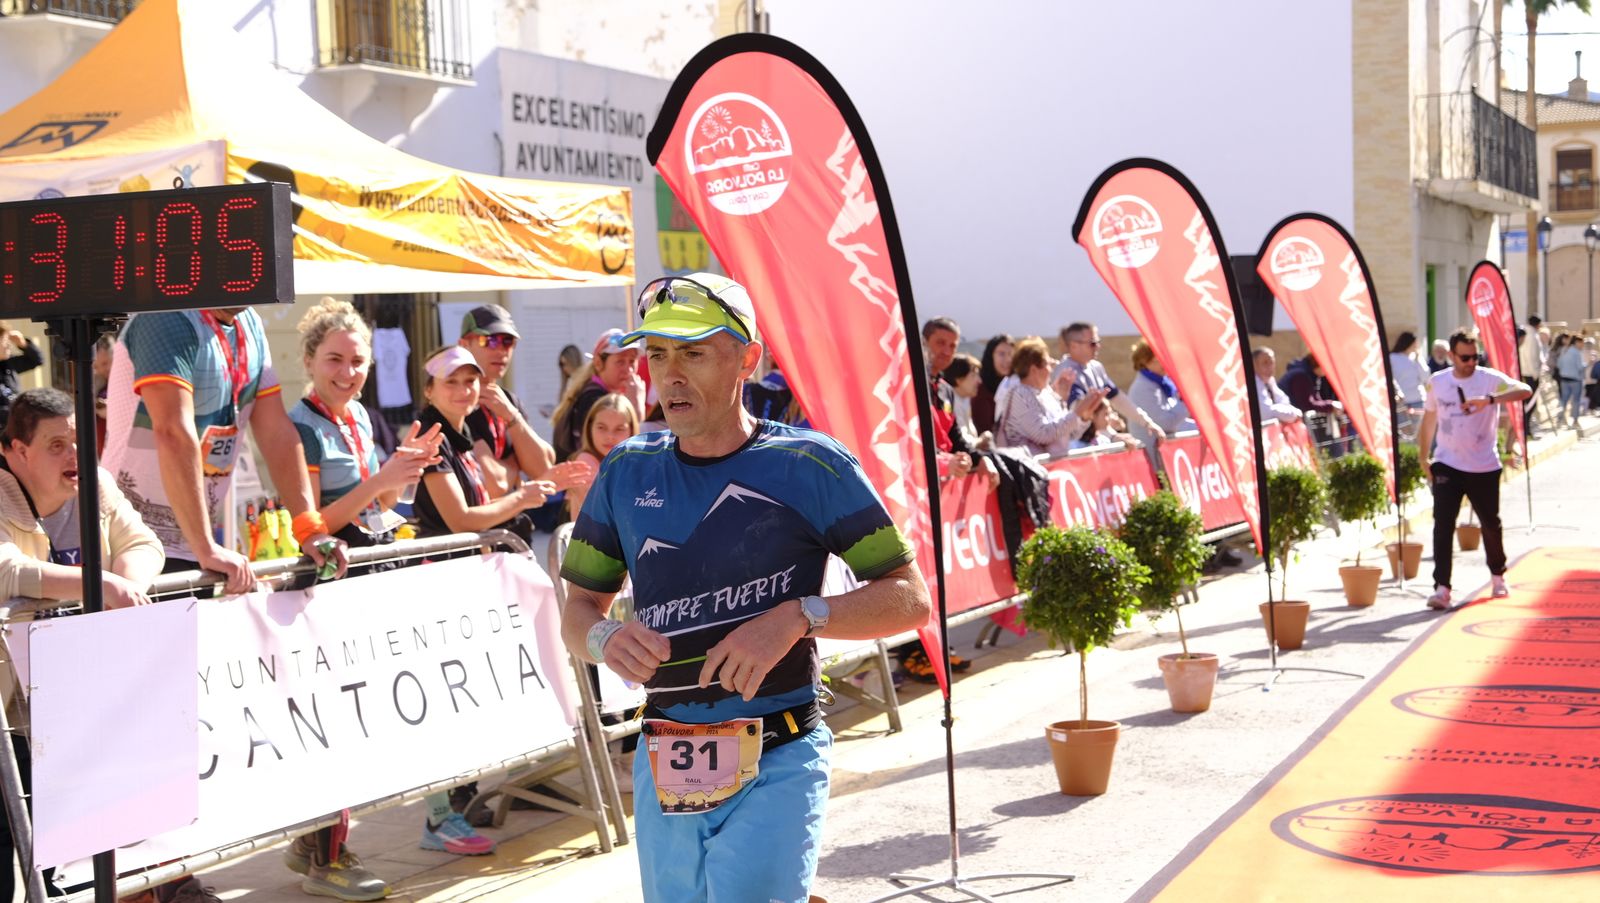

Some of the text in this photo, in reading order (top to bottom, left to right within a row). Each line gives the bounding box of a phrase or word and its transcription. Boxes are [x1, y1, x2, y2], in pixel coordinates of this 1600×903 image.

[512, 93, 645, 138] EXCELENTÍSIMO
[516, 142, 643, 182] AYUNTAMIENTO
[210, 437, 233, 455] 26
[634, 497, 664, 508] TMRG
[713, 564, 797, 613] FUERTE
[198, 604, 523, 695] YUNTAMIENTO DE
[670, 740, 717, 771] 31
[1338, 805, 1547, 824] POLVORA
